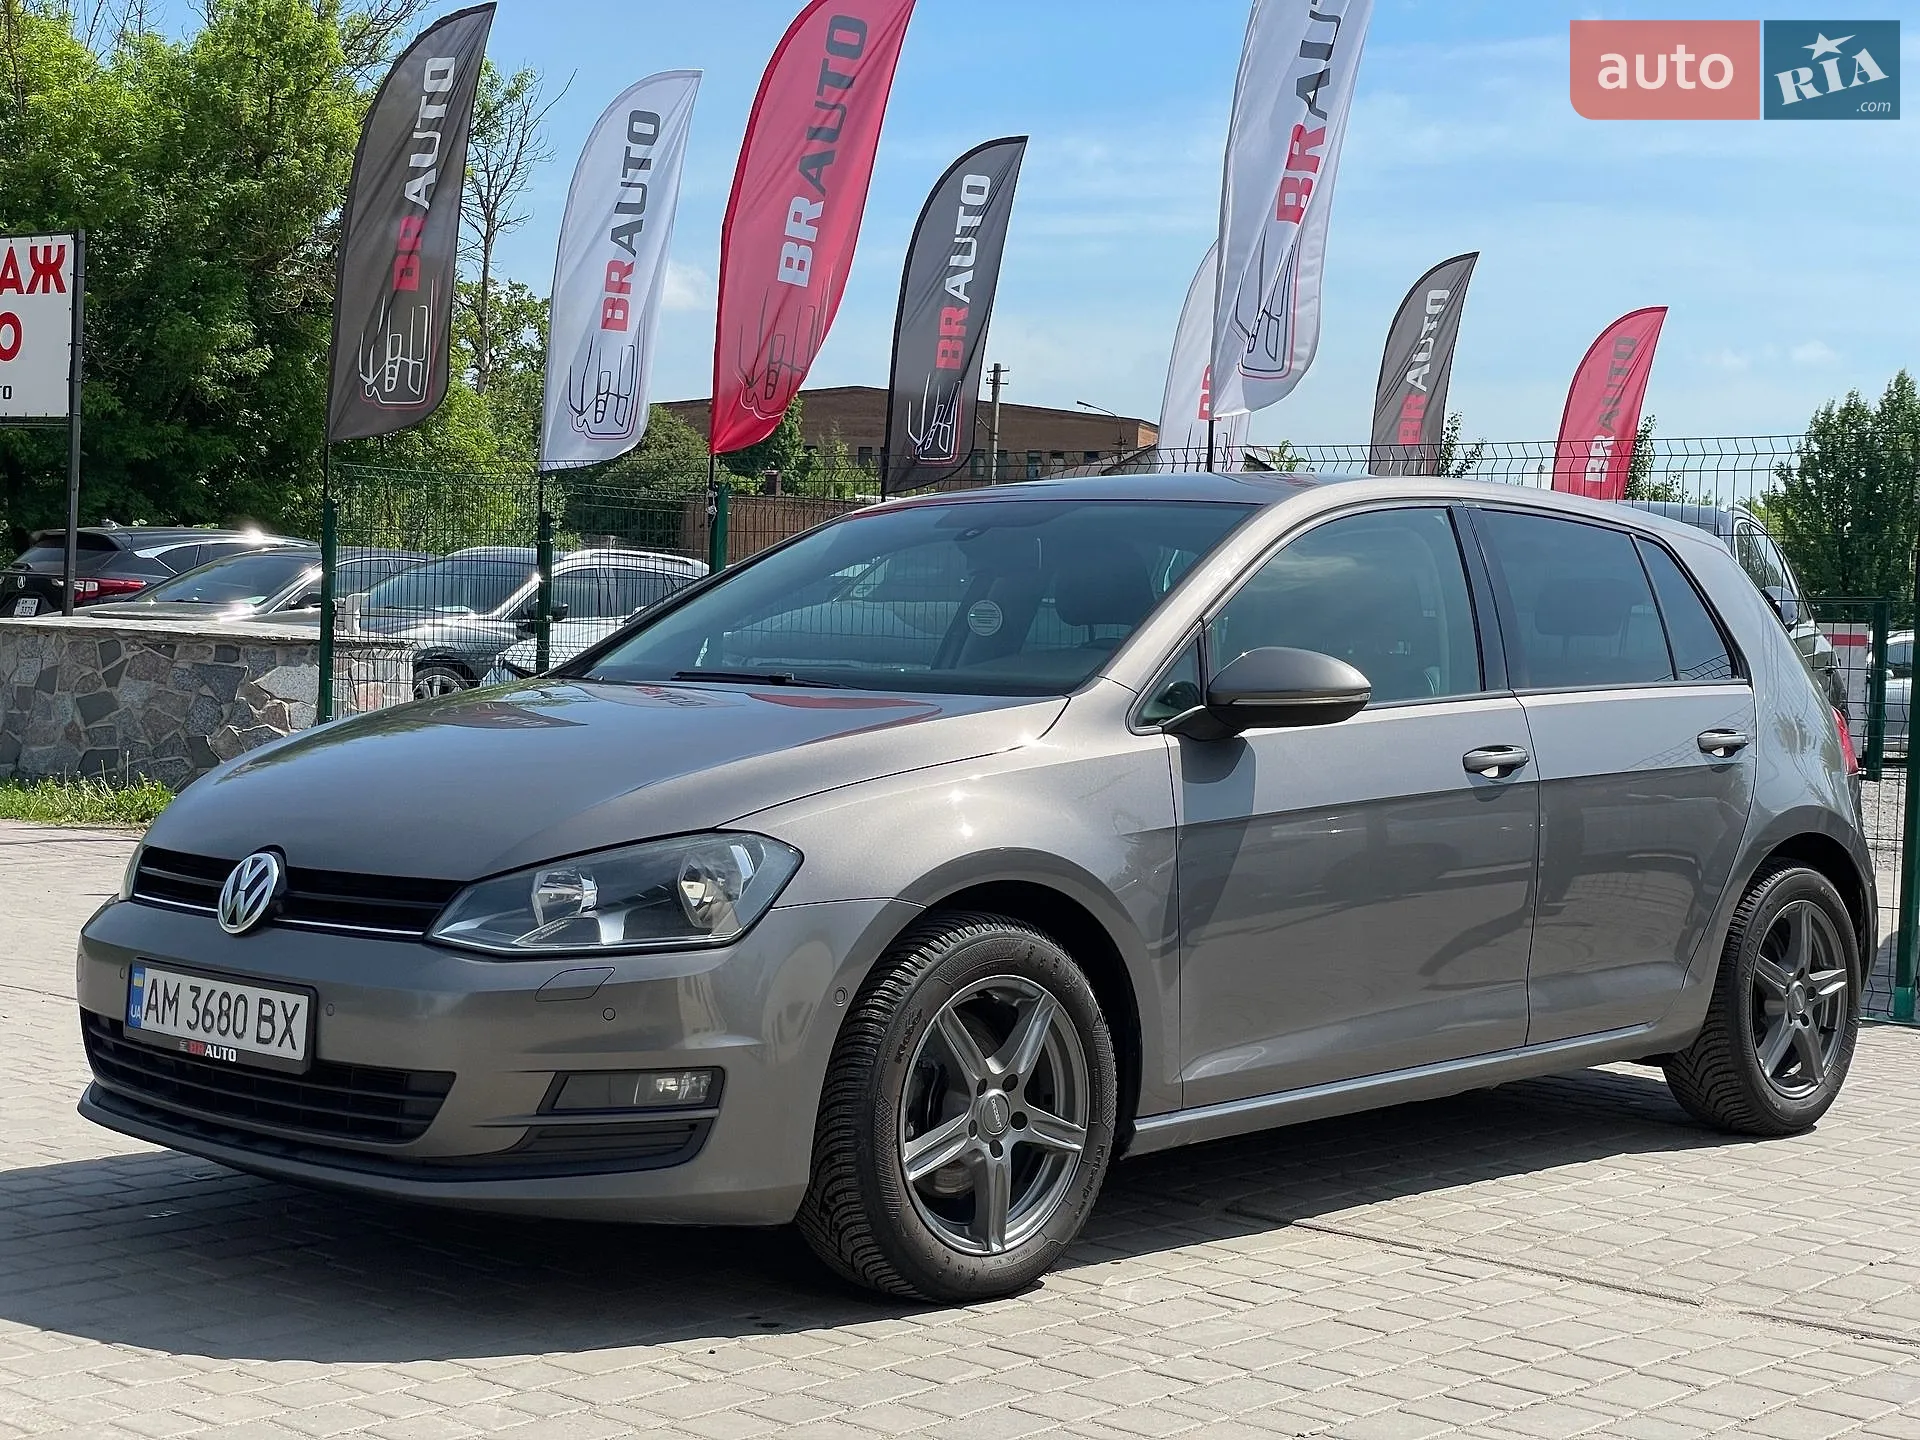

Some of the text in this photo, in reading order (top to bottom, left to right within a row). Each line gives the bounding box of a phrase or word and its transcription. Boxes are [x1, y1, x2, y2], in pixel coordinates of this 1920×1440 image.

[392, 56, 456, 292] BRAUTO
[776, 14, 868, 288] BRAUTO
[1275, 0, 1342, 225] BRAU
[600, 109, 661, 332] BRAUTO
[935, 174, 991, 370] BRAUTO
[1396, 289, 1450, 446] BRAUTO
[1584, 336, 1638, 483] BRAUTO
[130, 1003, 142, 1019] UA
[144, 978, 301, 1051] AM 3680 BX
